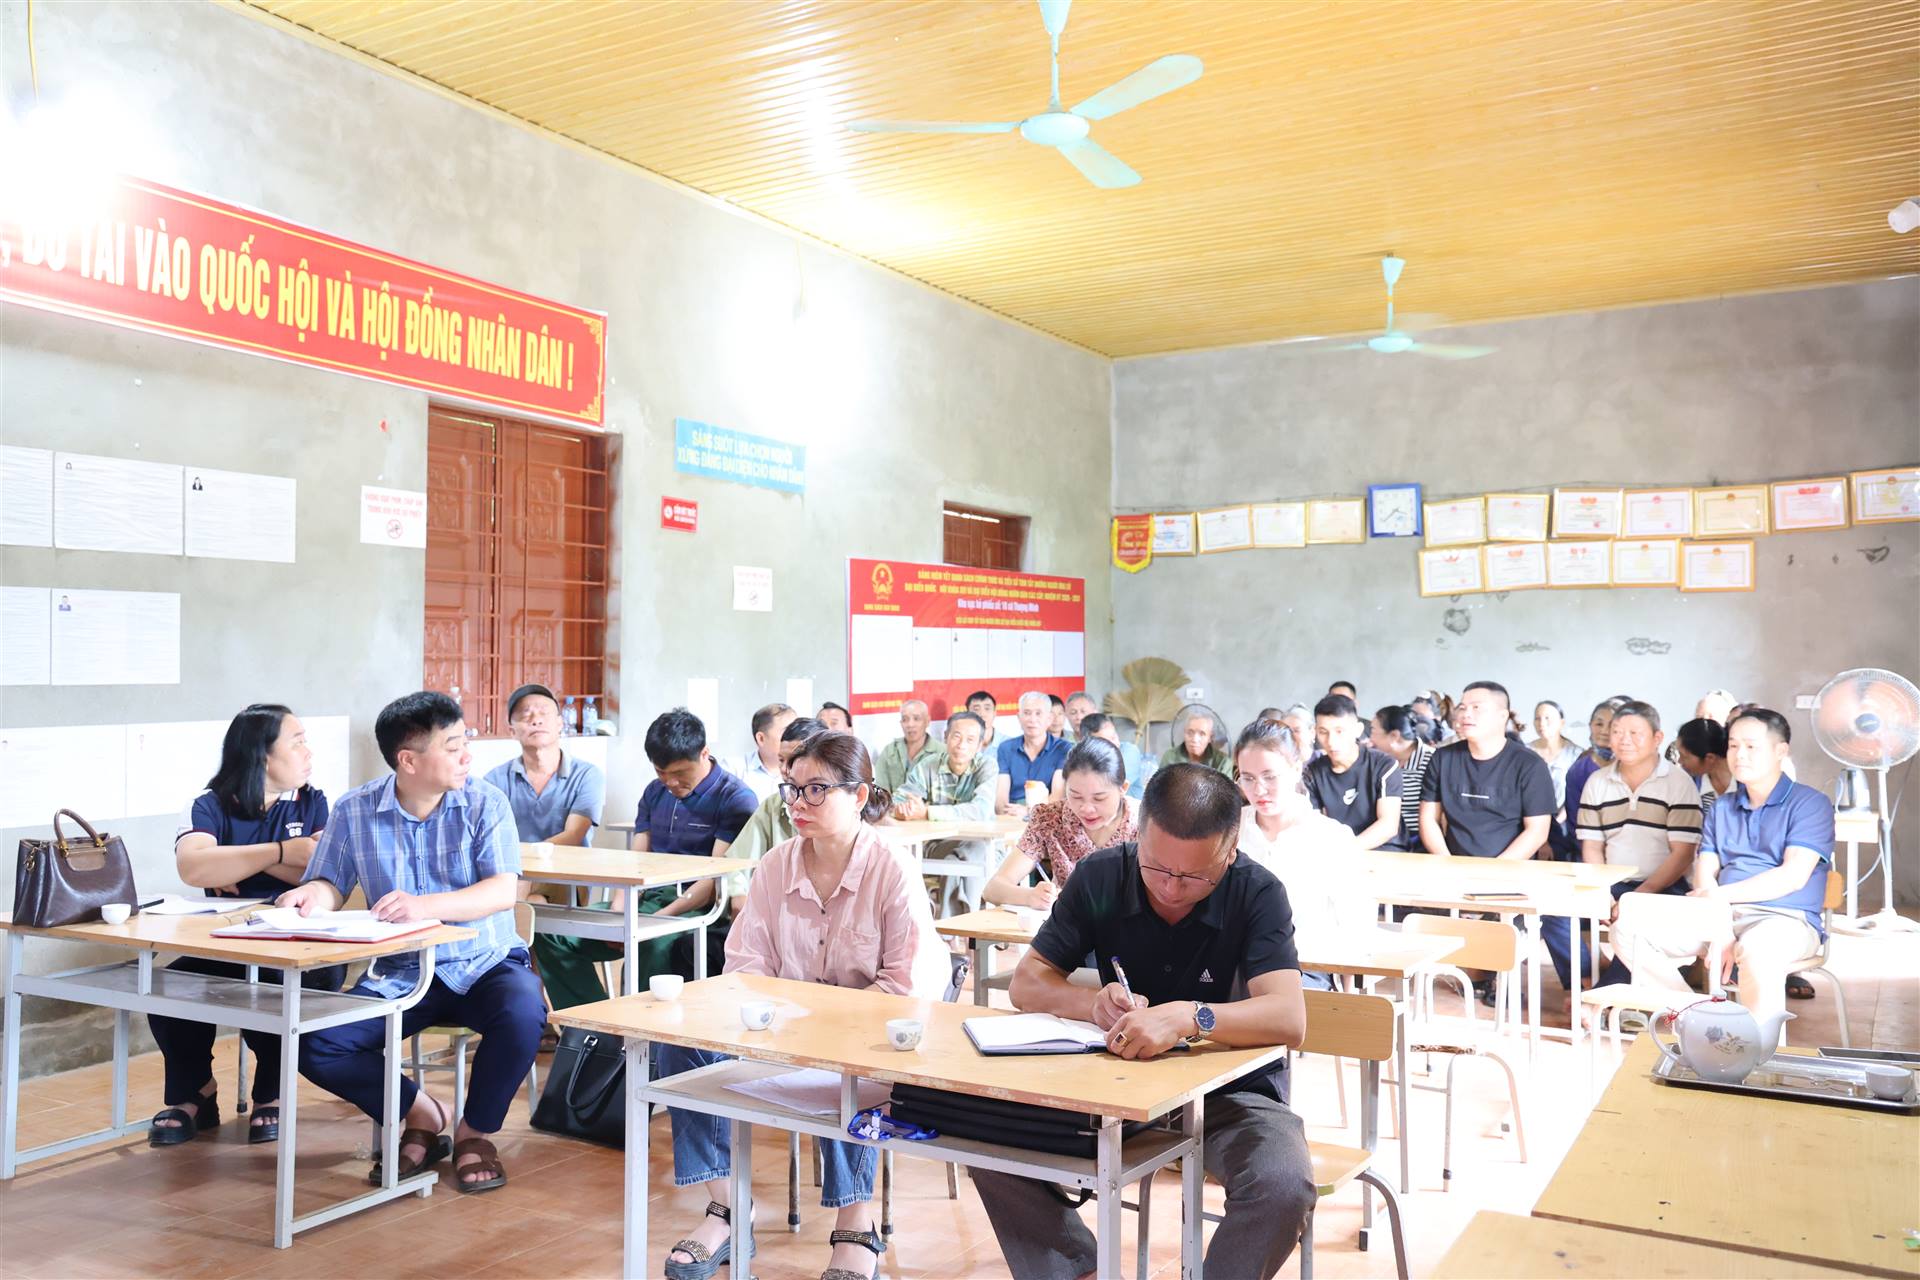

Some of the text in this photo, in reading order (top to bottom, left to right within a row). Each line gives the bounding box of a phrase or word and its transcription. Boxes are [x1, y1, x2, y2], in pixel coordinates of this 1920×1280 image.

[134, 217, 191, 301] VÀO
[200, 234, 271, 320] QUỐC
[277, 258, 320, 343] HỘI
[326, 270, 356, 341] VÀ
[361, 281, 400, 361] HỘI
[404, 286, 463, 366] ĐỒNG
[467, 313, 522, 380] NHÂN
[525, 324, 564, 389] DÂN
